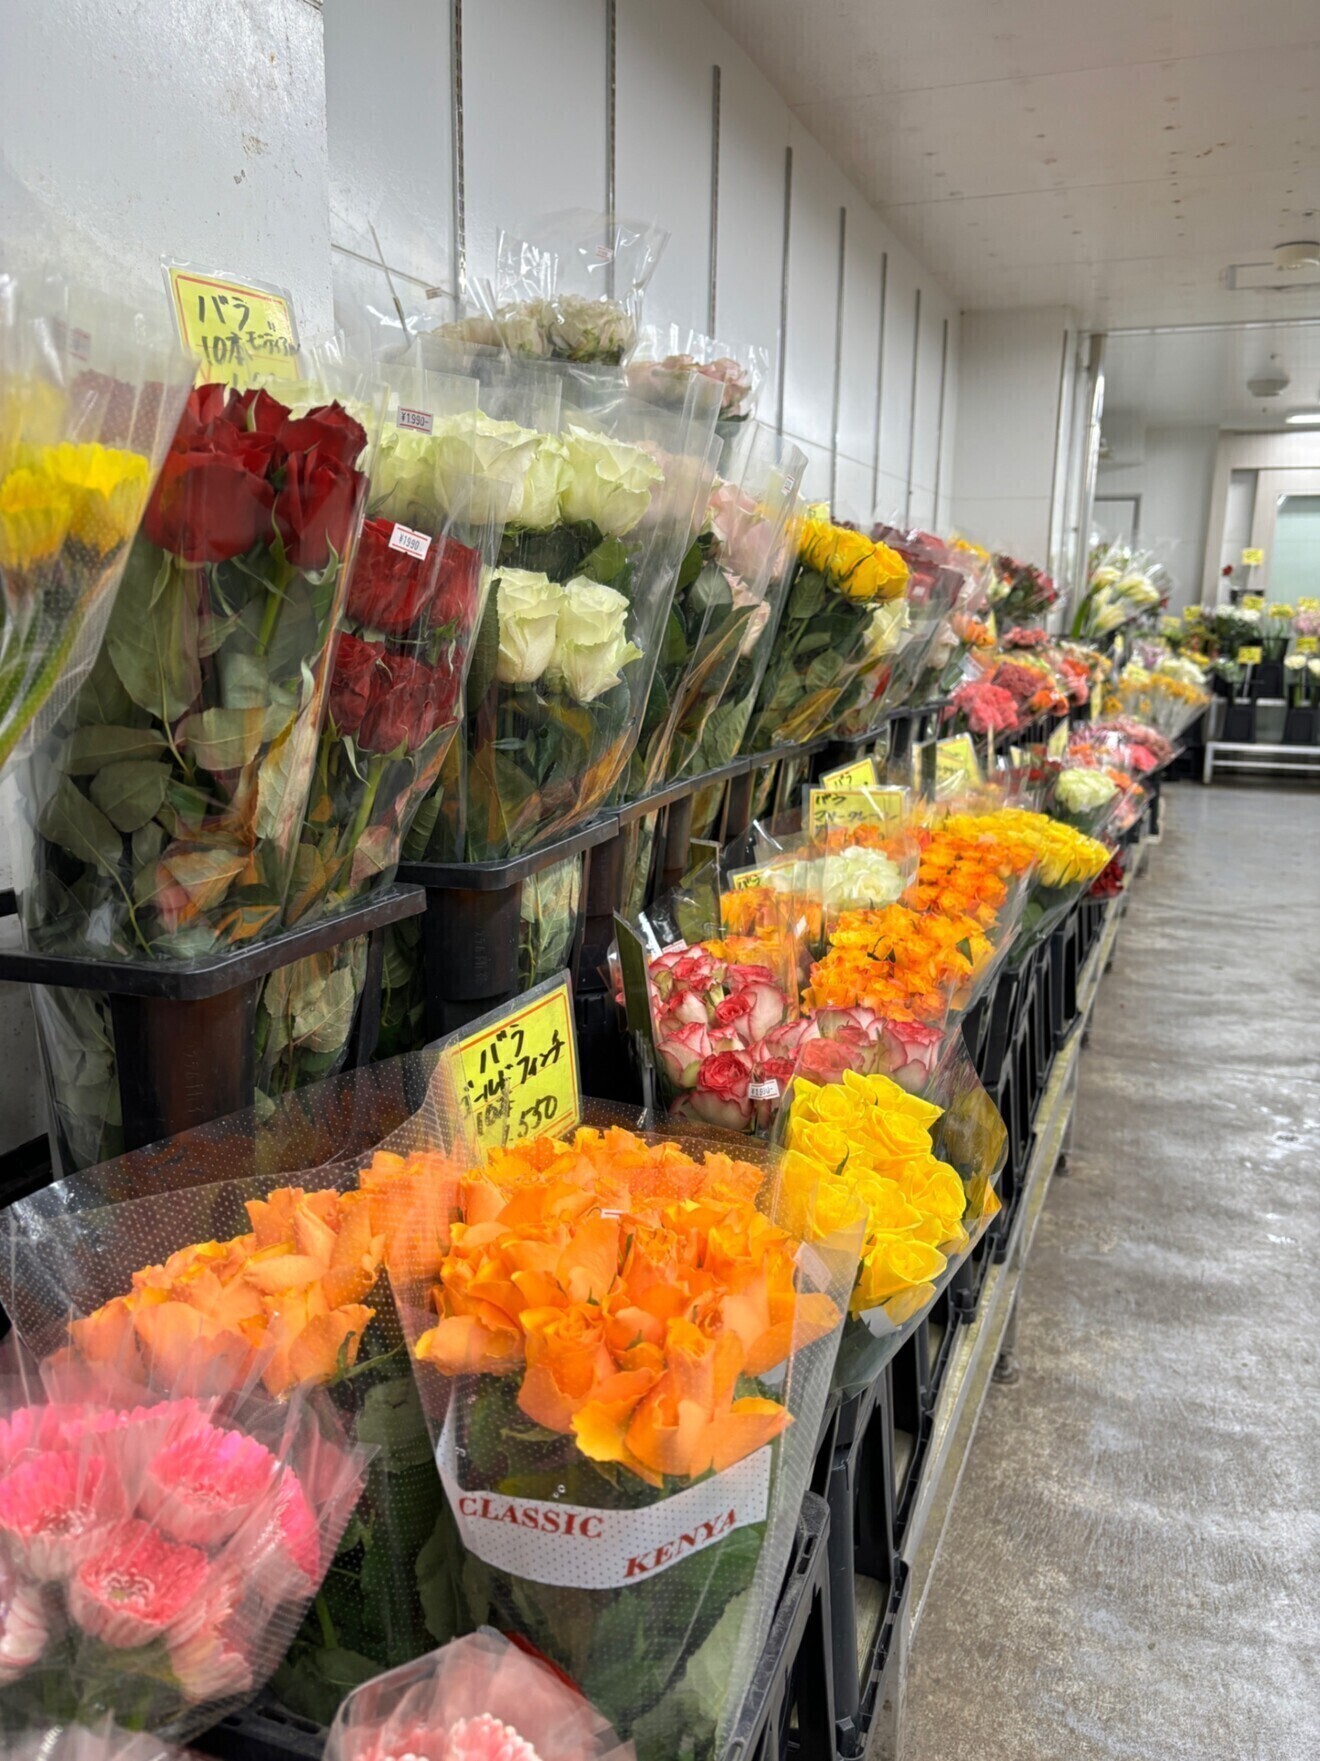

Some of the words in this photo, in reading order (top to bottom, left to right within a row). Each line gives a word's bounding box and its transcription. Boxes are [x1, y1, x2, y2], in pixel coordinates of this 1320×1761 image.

[198, 294, 250, 332] バラ
[479, 1024, 525, 1074] バラ
[459, 1497, 604, 1538] CLASSIC
[623, 1508, 737, 1579] KENYA
